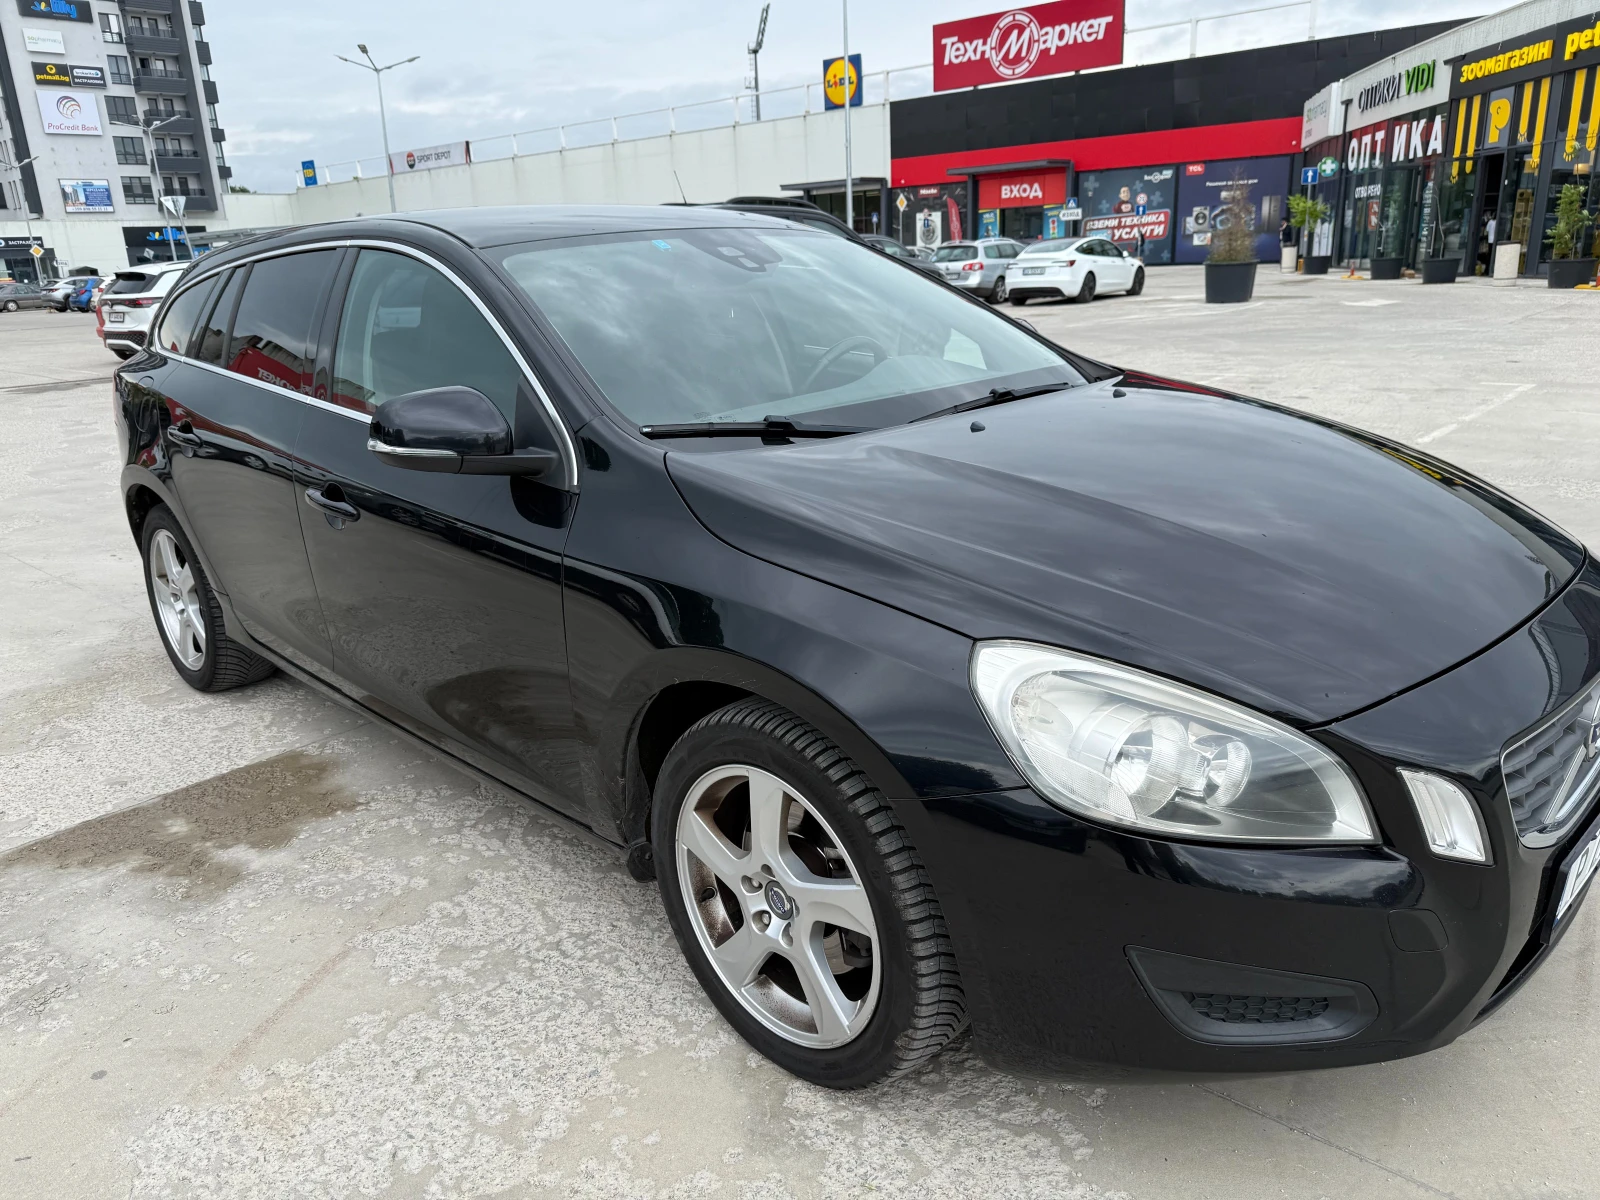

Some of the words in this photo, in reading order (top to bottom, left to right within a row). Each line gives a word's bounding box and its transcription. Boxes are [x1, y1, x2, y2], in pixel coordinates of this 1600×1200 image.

[1460, 40, 1553, 83] зоомагазин
[1405, 59, 1436, 95] VIDI
[47, 122, 80, 131] ProCredit
[81, 123, 99, 132] Bank
[416, 153, 433, 164] SPORT
[434, 150, 451, 161] DEPOT
[1001, 183, 1042, 199] ВХОД
[1086, 217, 1119, 230] ВЗЕМИ
